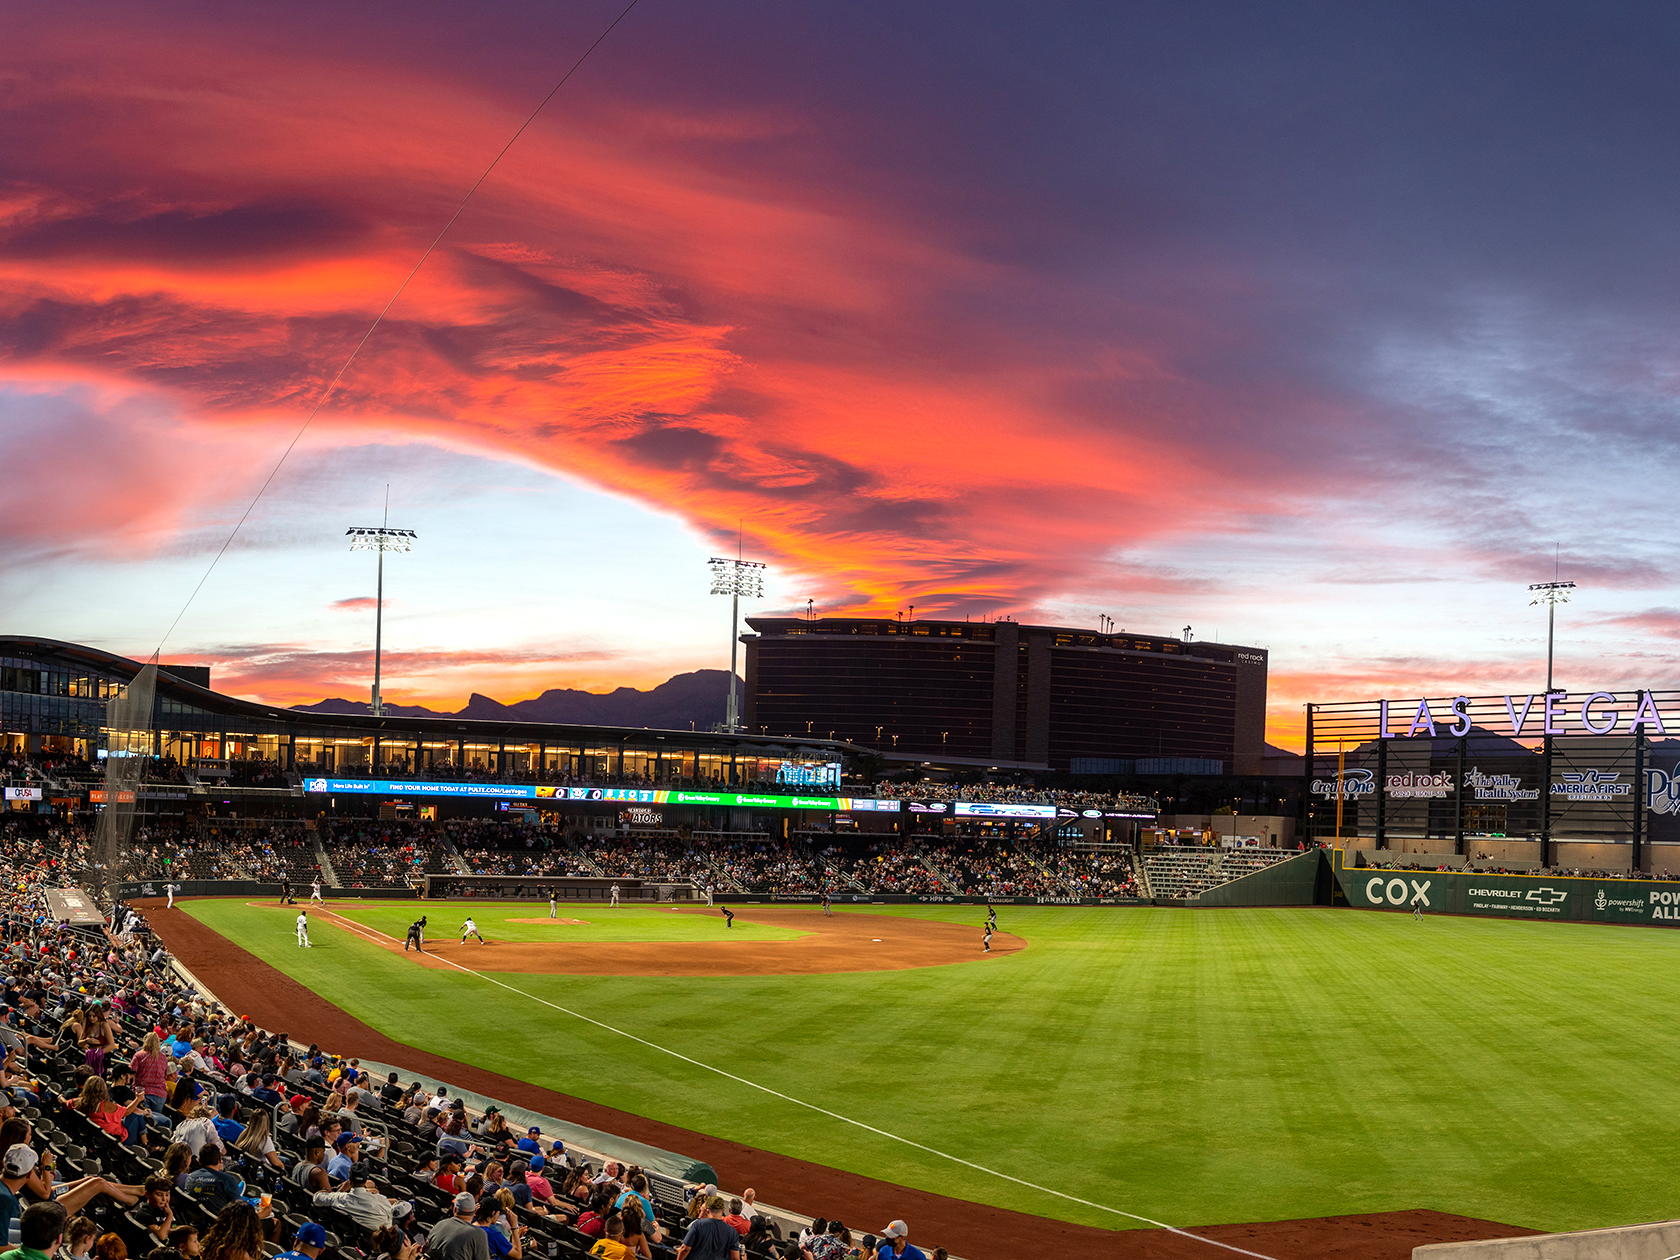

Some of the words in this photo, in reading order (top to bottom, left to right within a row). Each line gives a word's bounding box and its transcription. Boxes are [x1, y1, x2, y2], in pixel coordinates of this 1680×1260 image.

[1237, 652, 1250, 660] red
[1250, 654, 1264, 662] rock
[1380, 695, 1472, 738] LAS
[1503, 688, 1666, 738] VEGA
[1385, 770, 1413, 788] red
[1414, 770, 1454, 788] rock
[1475, 773, 1492, 787] The
[1490, 774, 1521, 791] Valley
[555, 788, 565, 799] 0
[606, 788, 613, 797] B
[618, 789, 625, 797] S
[1474, 787, 1509, 799] Health
[1549, 782, 1597, 795] AMERICA
[1597, 783, 1631, 795] FIRST
[592, 789, 602, 800] 0
[1365, 876, 1432, 907] COX
[1468, 888, 1523, 899] CHEVROLET
[1473, 902, 1489, 910] FINDLAY
[1607, 899, 1645, 909] powershift
